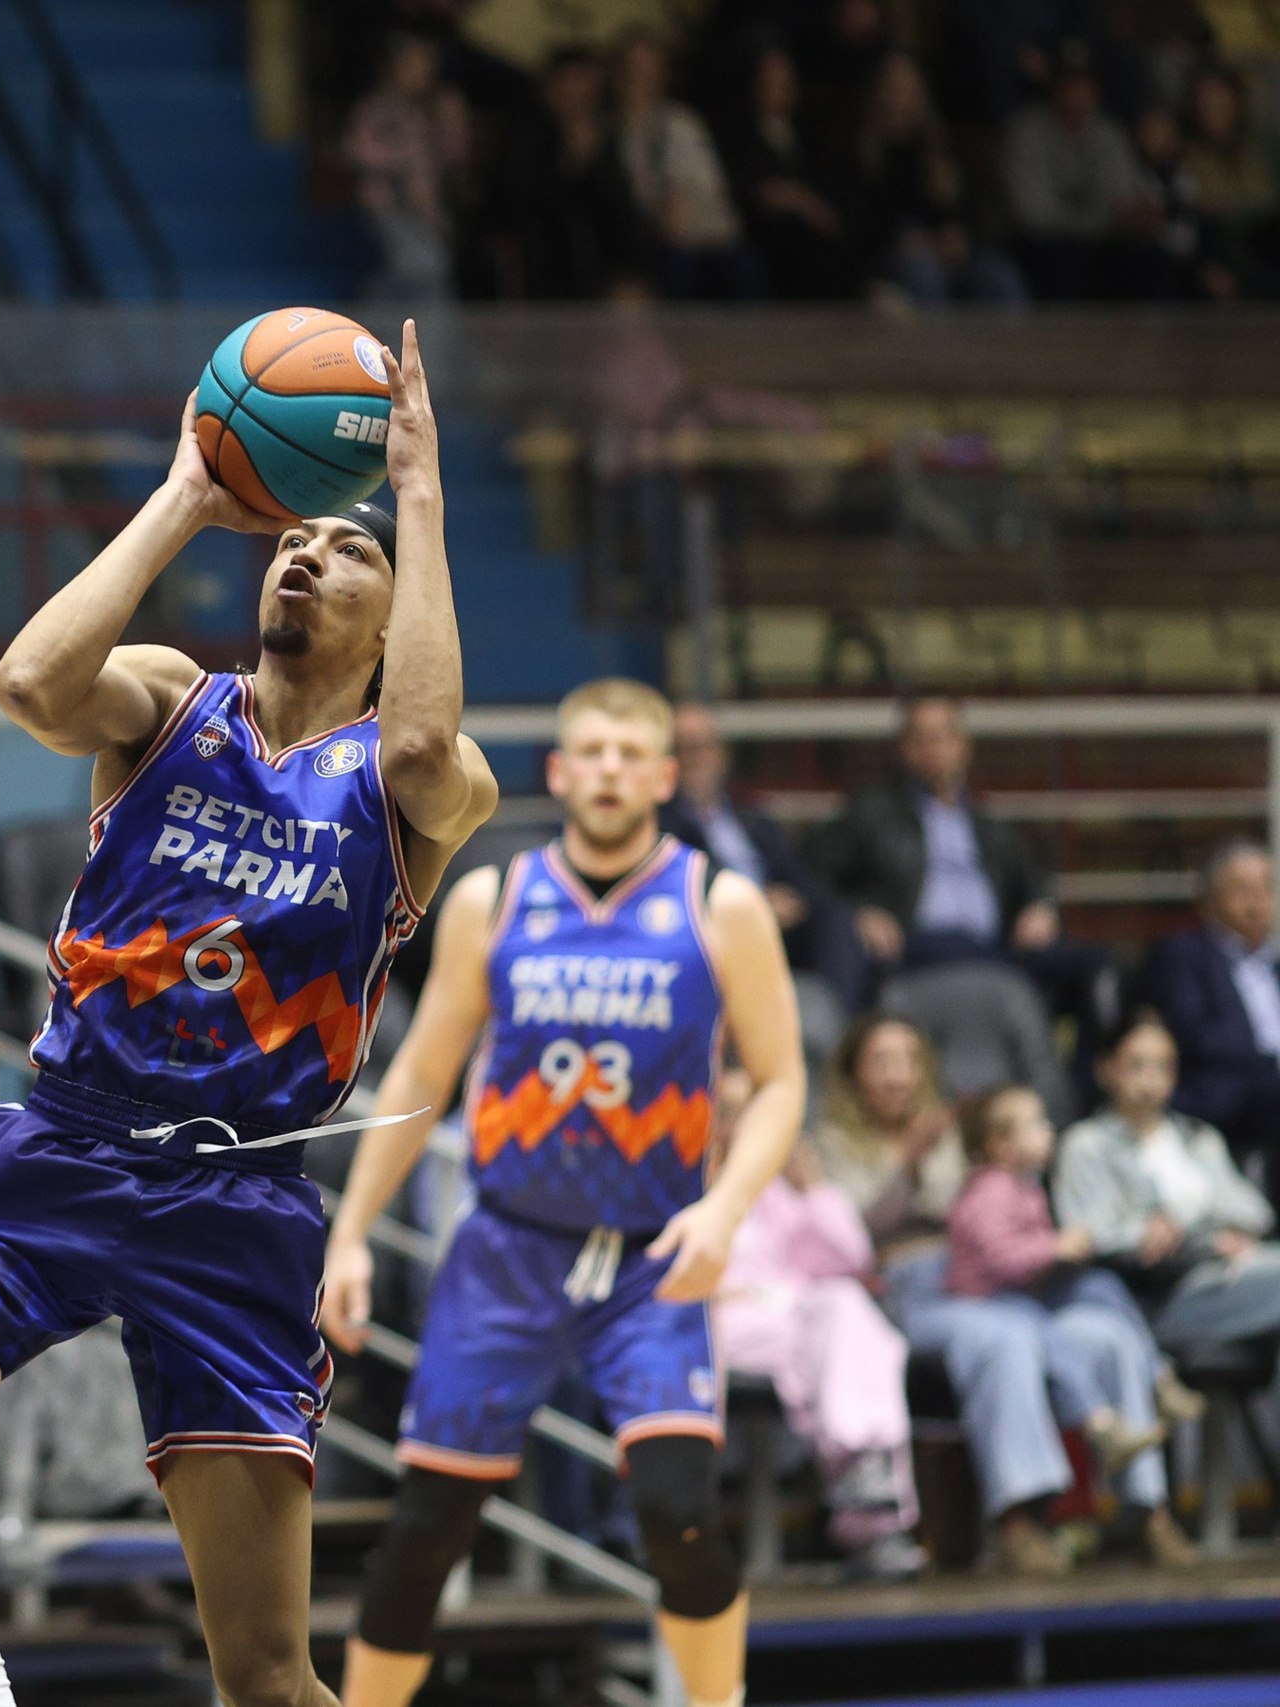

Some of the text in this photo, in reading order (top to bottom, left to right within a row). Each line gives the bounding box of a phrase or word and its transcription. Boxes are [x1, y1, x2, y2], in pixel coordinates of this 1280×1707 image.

[334, 411, 388, 444] SIB
[165, 784, 354, 857] BETCITY
[149, 824, 349, 911] PARMA
[182, 919, 246, 991] 6
[509, 955, 682, 988] BETCITY
[511, 987, 672, 1031] PARMA
[538, 1038, 632, 1110] 93
